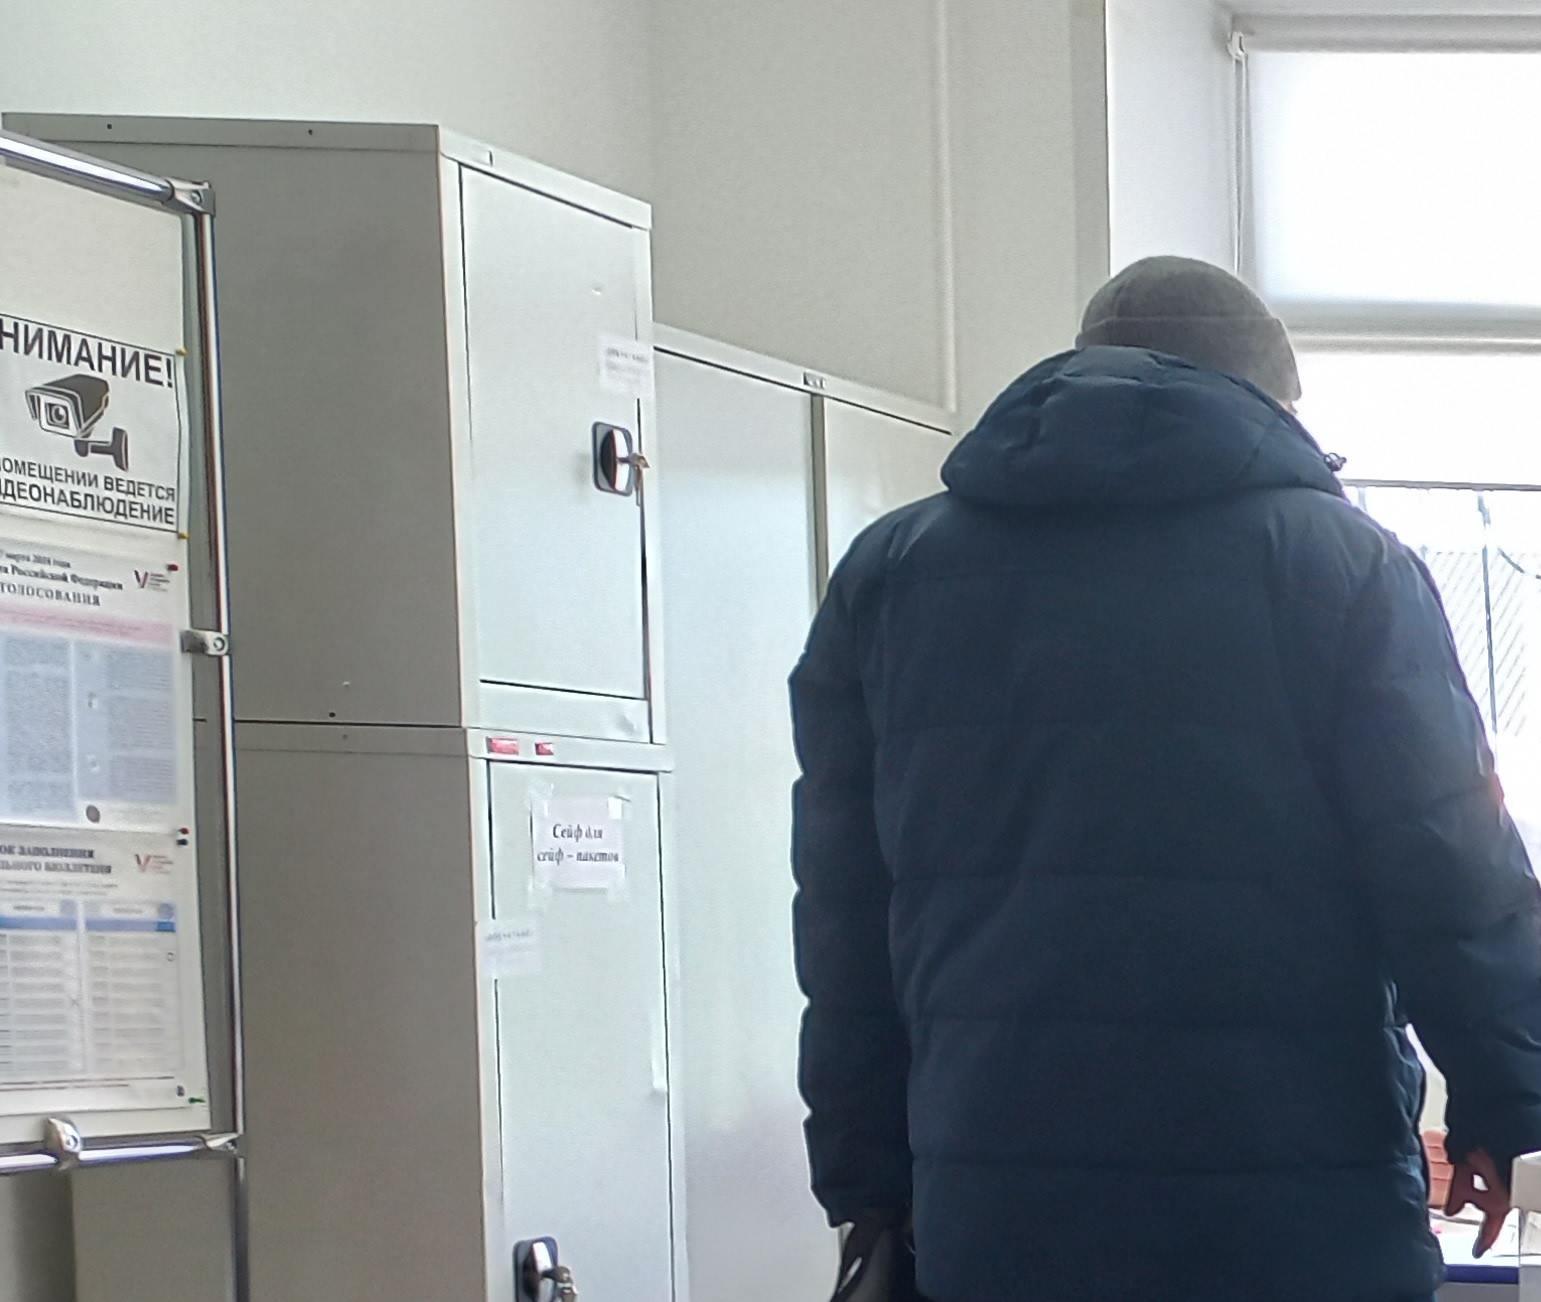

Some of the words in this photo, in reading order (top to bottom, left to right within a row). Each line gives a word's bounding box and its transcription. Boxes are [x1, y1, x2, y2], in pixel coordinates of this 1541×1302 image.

[0, 317, 173, 388] НИМАНИЕ!
[0, 457, 99, 488] ОМЕЩЕНИИ
[103, 475, 175, 502] ВЕДЕТСЯ
[0, 478, 175, 525] ДЕОНАБЛЮДЕНИЕ
[552, 823, 582, 843] Сейф
[537, 847, 564, 866] сейф
[576, 852, 619, 862] пакетов
